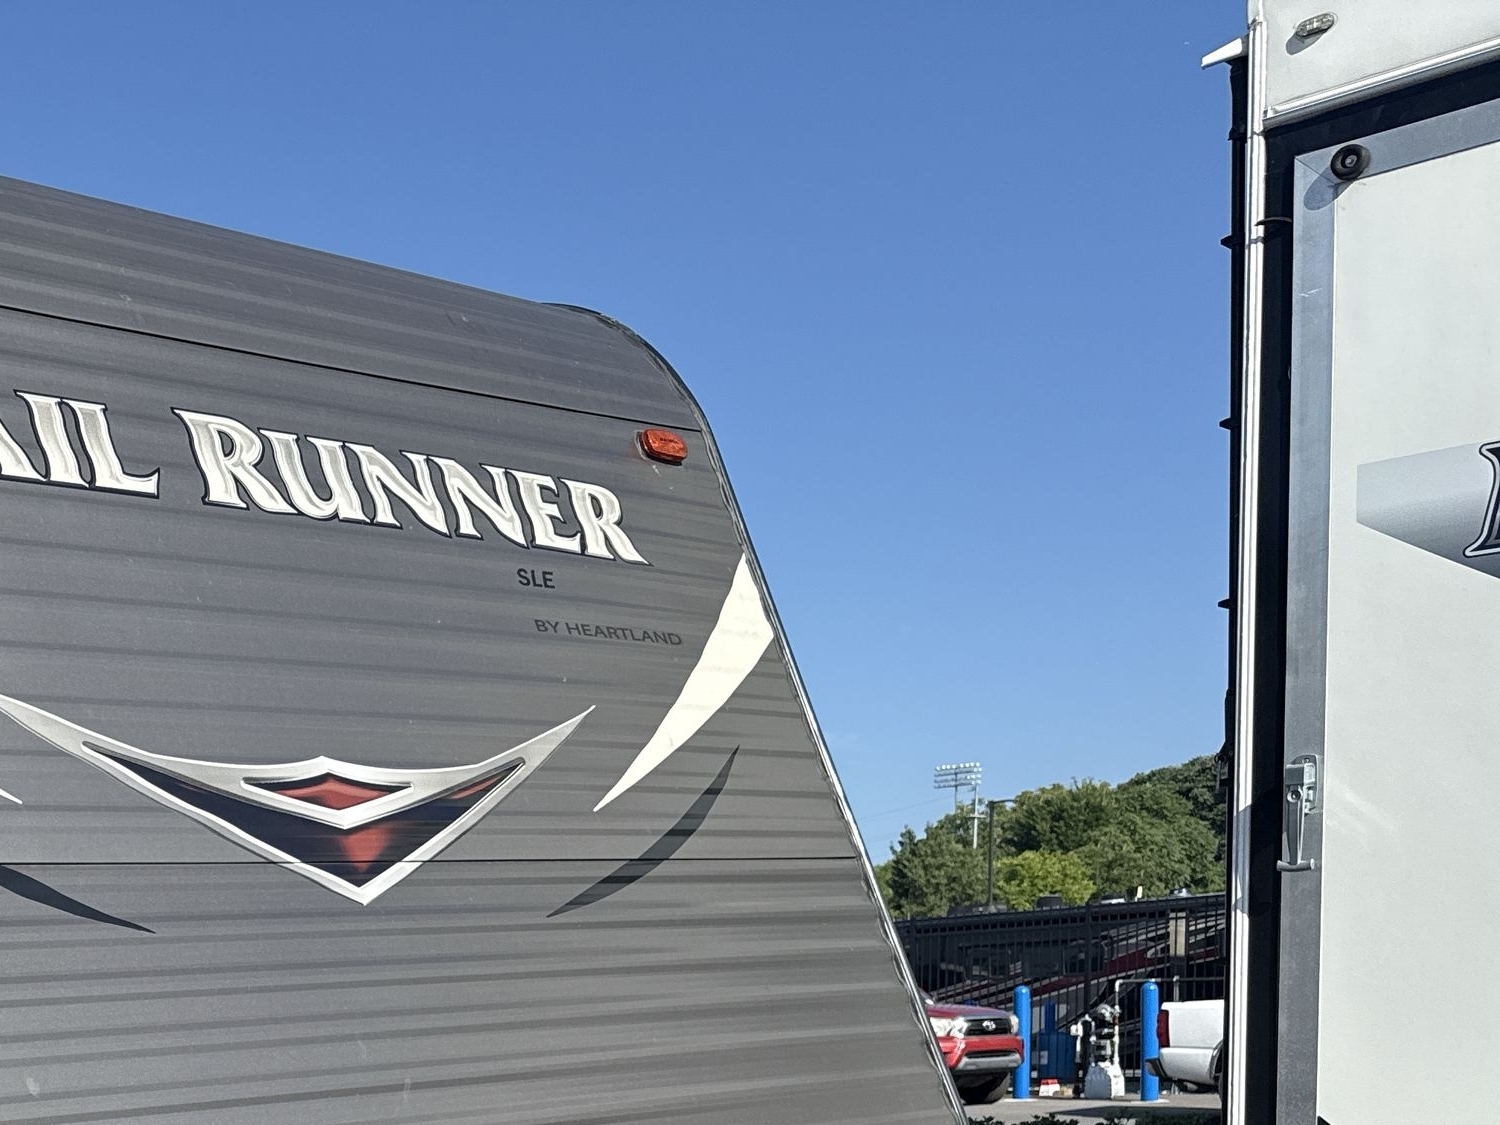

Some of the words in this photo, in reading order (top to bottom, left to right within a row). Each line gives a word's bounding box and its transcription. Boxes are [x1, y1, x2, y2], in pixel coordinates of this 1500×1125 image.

[170, 406, 656, 567] RUNNER
[516, 567, 556, 589] SLE
[534, 619, 560, 632] BY
[565, 622, 683, 646] HEARTLAND
